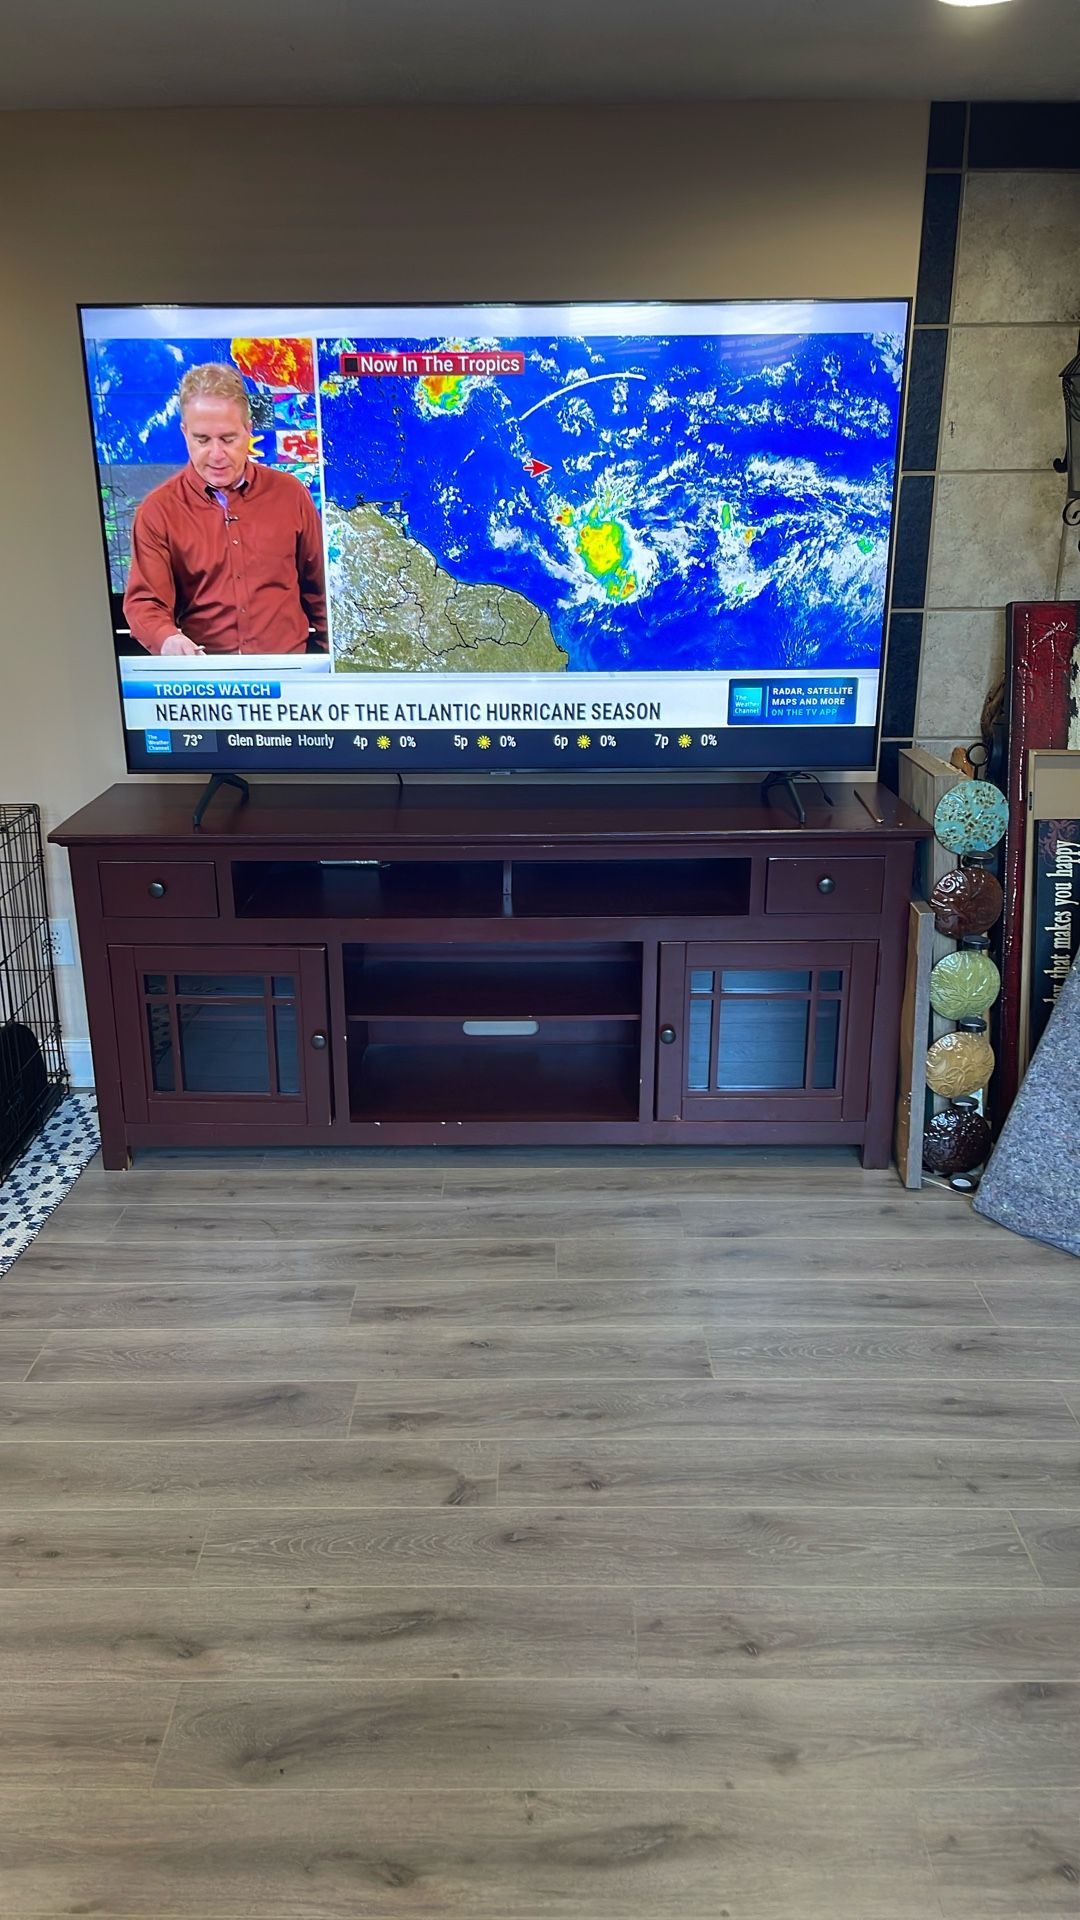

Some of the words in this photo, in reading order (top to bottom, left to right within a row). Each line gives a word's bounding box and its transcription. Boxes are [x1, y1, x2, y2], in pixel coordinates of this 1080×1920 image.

[361, 357, 398, 372] Now
[402, 356, 417, 372] In
[422, 356, 453, 372] The
[457, 356, 520, 375] Tropics
[154, 683, 215, 696] TROPICS
[217, 683, 271, 696] WATCH
[773, 687, 805, 696] RADAR,
[807, 687, 853, 695] SATELLITE
[772, 698, 797, 706] MAPS
[820, 697, 845, 705] MORE
[155, 703, 232, 721] NEARING
[238, 703, 272, 721] THE
[277, 703, 323, 721] PEAK
[328, 703, 349, 721] OF
[354, 703, 389, 721] THE
[394, 703, 481, 721] ATLANTIC
[486, 703, 586, 721] HURRICANE
[591, 702, 661, 720] SEASON
[805, 708, 817, 716] TV
[819, 708, 838, 716] APP
[183, 734, 203, 747] 73°
[227, 734, 253, 747] Glen
[256, 734, 292, 747] Burnie
[298, 734, 335, 749] Hourly
[353, 735, 368, 750] 4p
[399, 736, 416, 748] 0%
[453, 735, 468, 750] 5p
[500, 735, 516, 748] 0%
[553, 735, 568, 750] 6p
[600, 735, 616, 747] 0%
[654, 734, 669, 749] 7p
[700, 734, 717, 747] 0%
[1046, 839, 1080, 878] happy
[1055, 882, 1080, 907] you
[1044, 910, 1072, 950] makes
[1043, 953, 1071, 979] that
